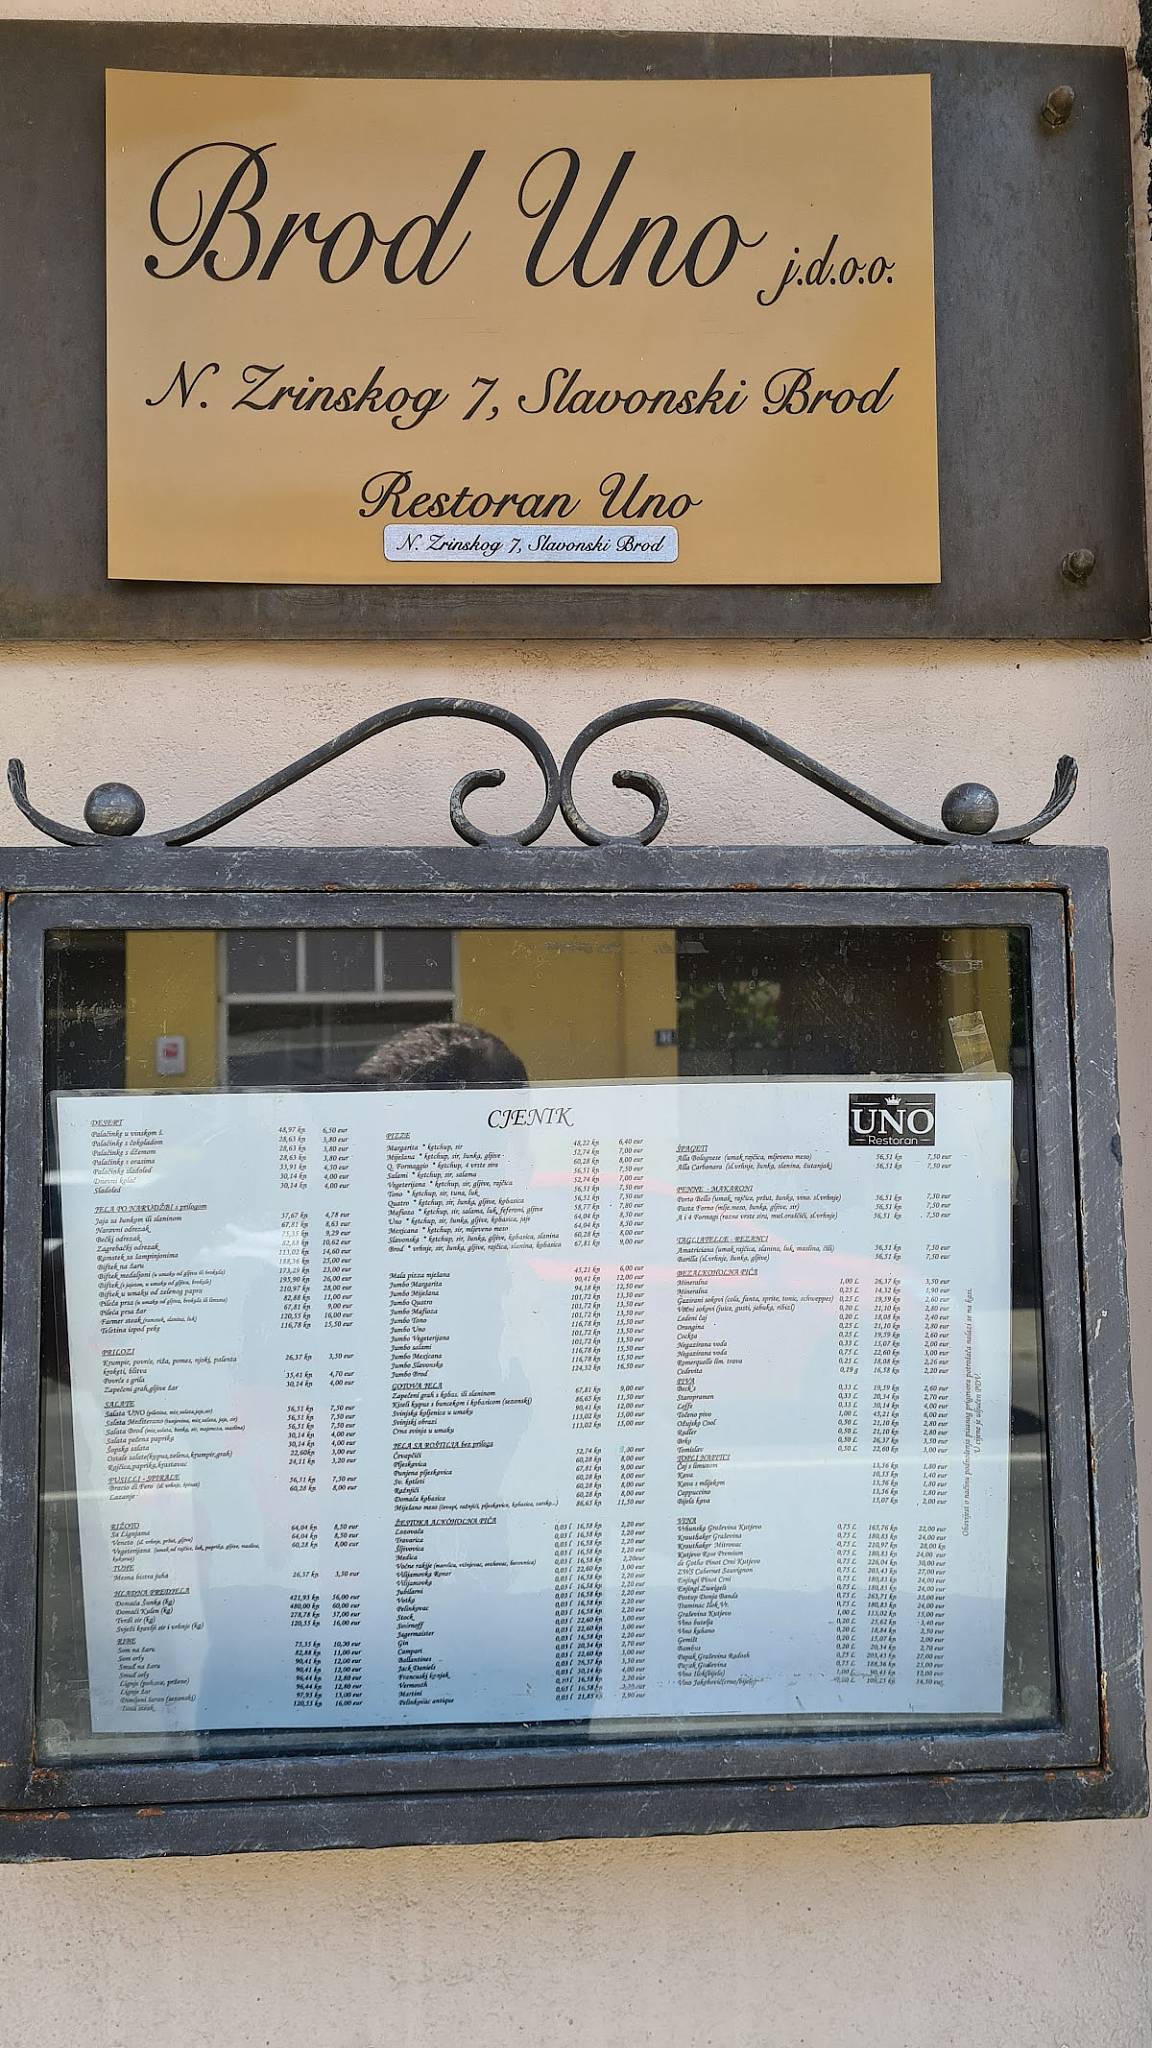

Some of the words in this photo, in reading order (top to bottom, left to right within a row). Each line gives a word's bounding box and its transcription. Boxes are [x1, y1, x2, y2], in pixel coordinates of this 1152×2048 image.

[145, 142, 486, 286] Brod
[518, 148, 768, 289] Uno
[757, 234, 895, 306] j.d.o.o.
[146, 361, 220, 409] N.
[232, 364, 449, 430] Zrinskog
[463, 376, 499, 421] 7,
[518, 367, 748, 415] Slavonski
[763, 367, 901, 415] Brod
[359, 470, 581, 520] Restoran
[599, 472, 703, 520] Uno
[396, 533, 423, 551] N.
[425, 534, 504, 557] Zrinskog
[527, 534, 611, 552] Slavonski
[615, 534, 667, 552] Brod
[488, 1108, 574, 1129] CJENIK
[850, 1108, 935, 1135] UNO
[867, 1135, 919, 1146] Restoran
